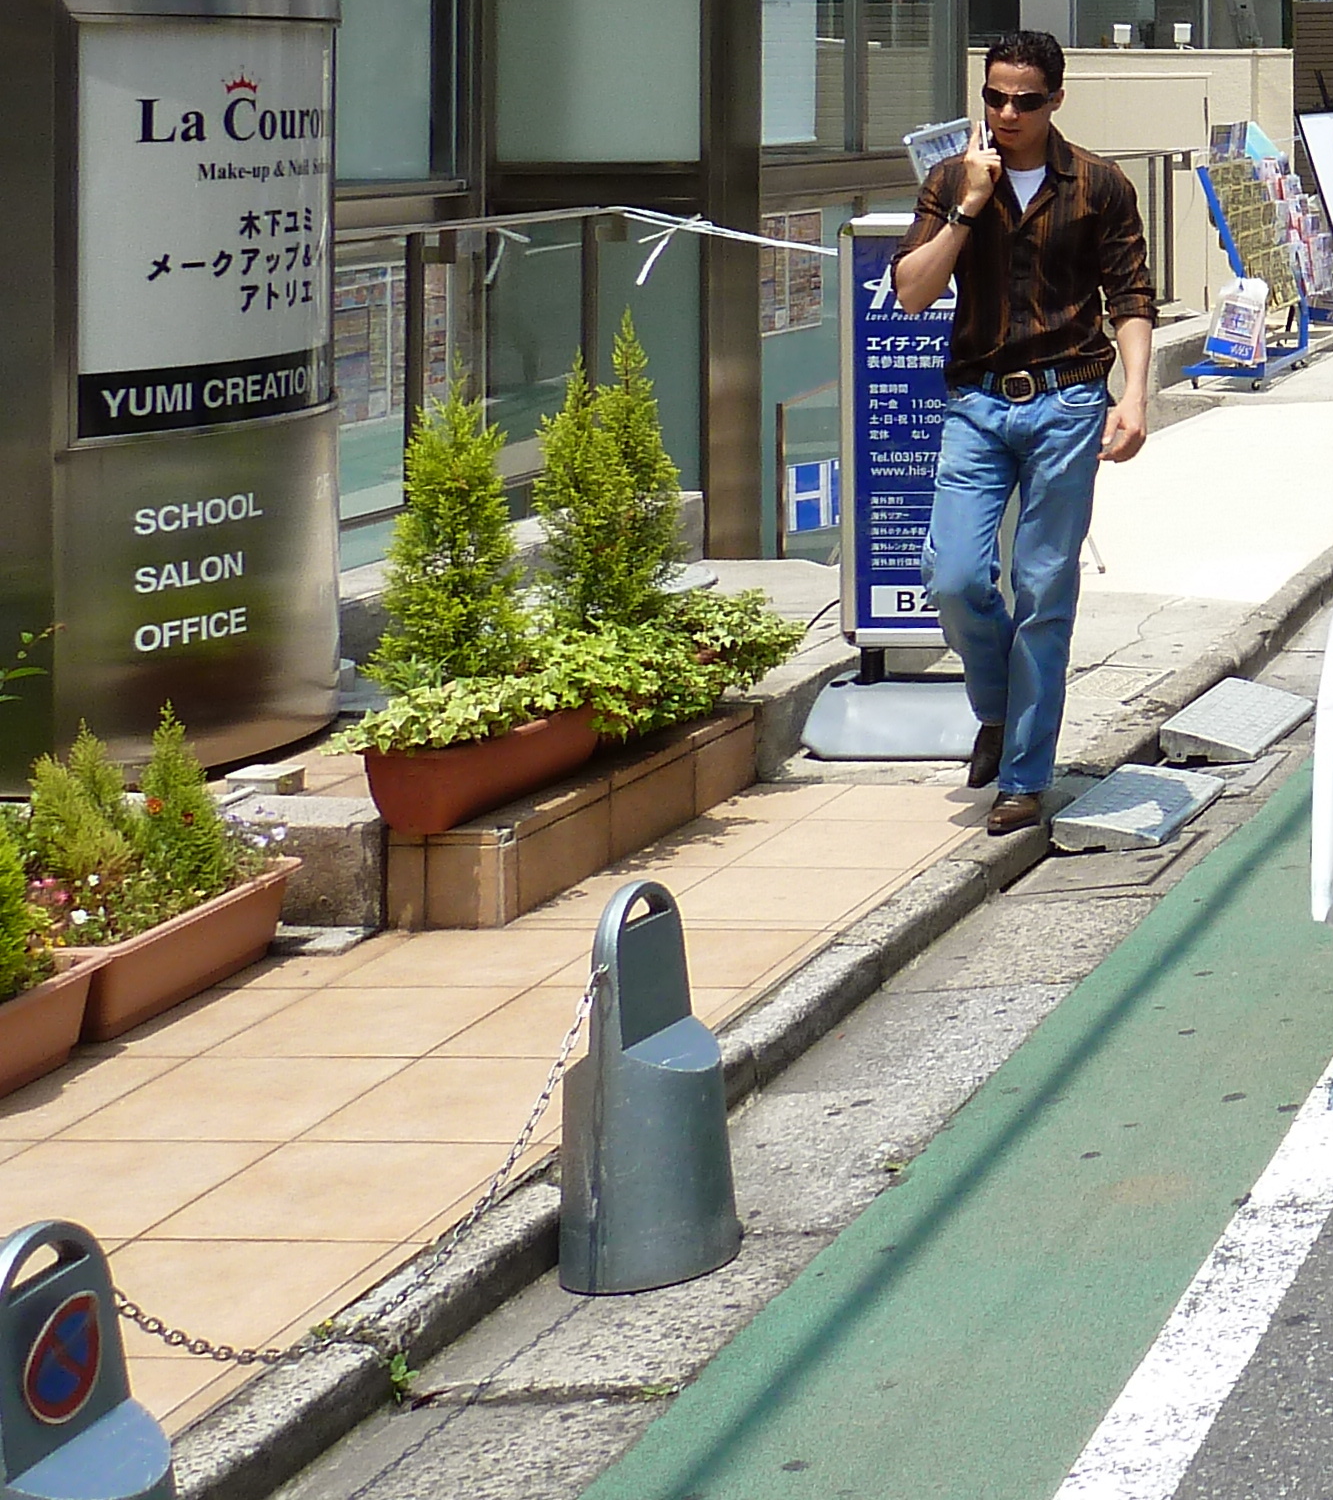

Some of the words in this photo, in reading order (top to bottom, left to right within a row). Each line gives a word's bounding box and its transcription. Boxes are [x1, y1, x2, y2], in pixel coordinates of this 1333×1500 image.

[135, 98, 207, 144] La
[197, 161, 271, 183] Make-up
[273, 160, 285, 178] &
[238, 207, 313, 240] 木下ユミ
[239, 279, 313, 313] アトリエ
[866, 355, 945, 369] 表参道営業所
[100, 381, 193, 419] YUMI
[868, 383, 909, 394] 営業時間
[868, 429, 890, 440] 定休
[911, 429, 930, 440] なし
[133, 491, 263, 536] SCHOOL
[133, 550, 244, 595] SALON
[133, 606, 248, 653] OFFICE
